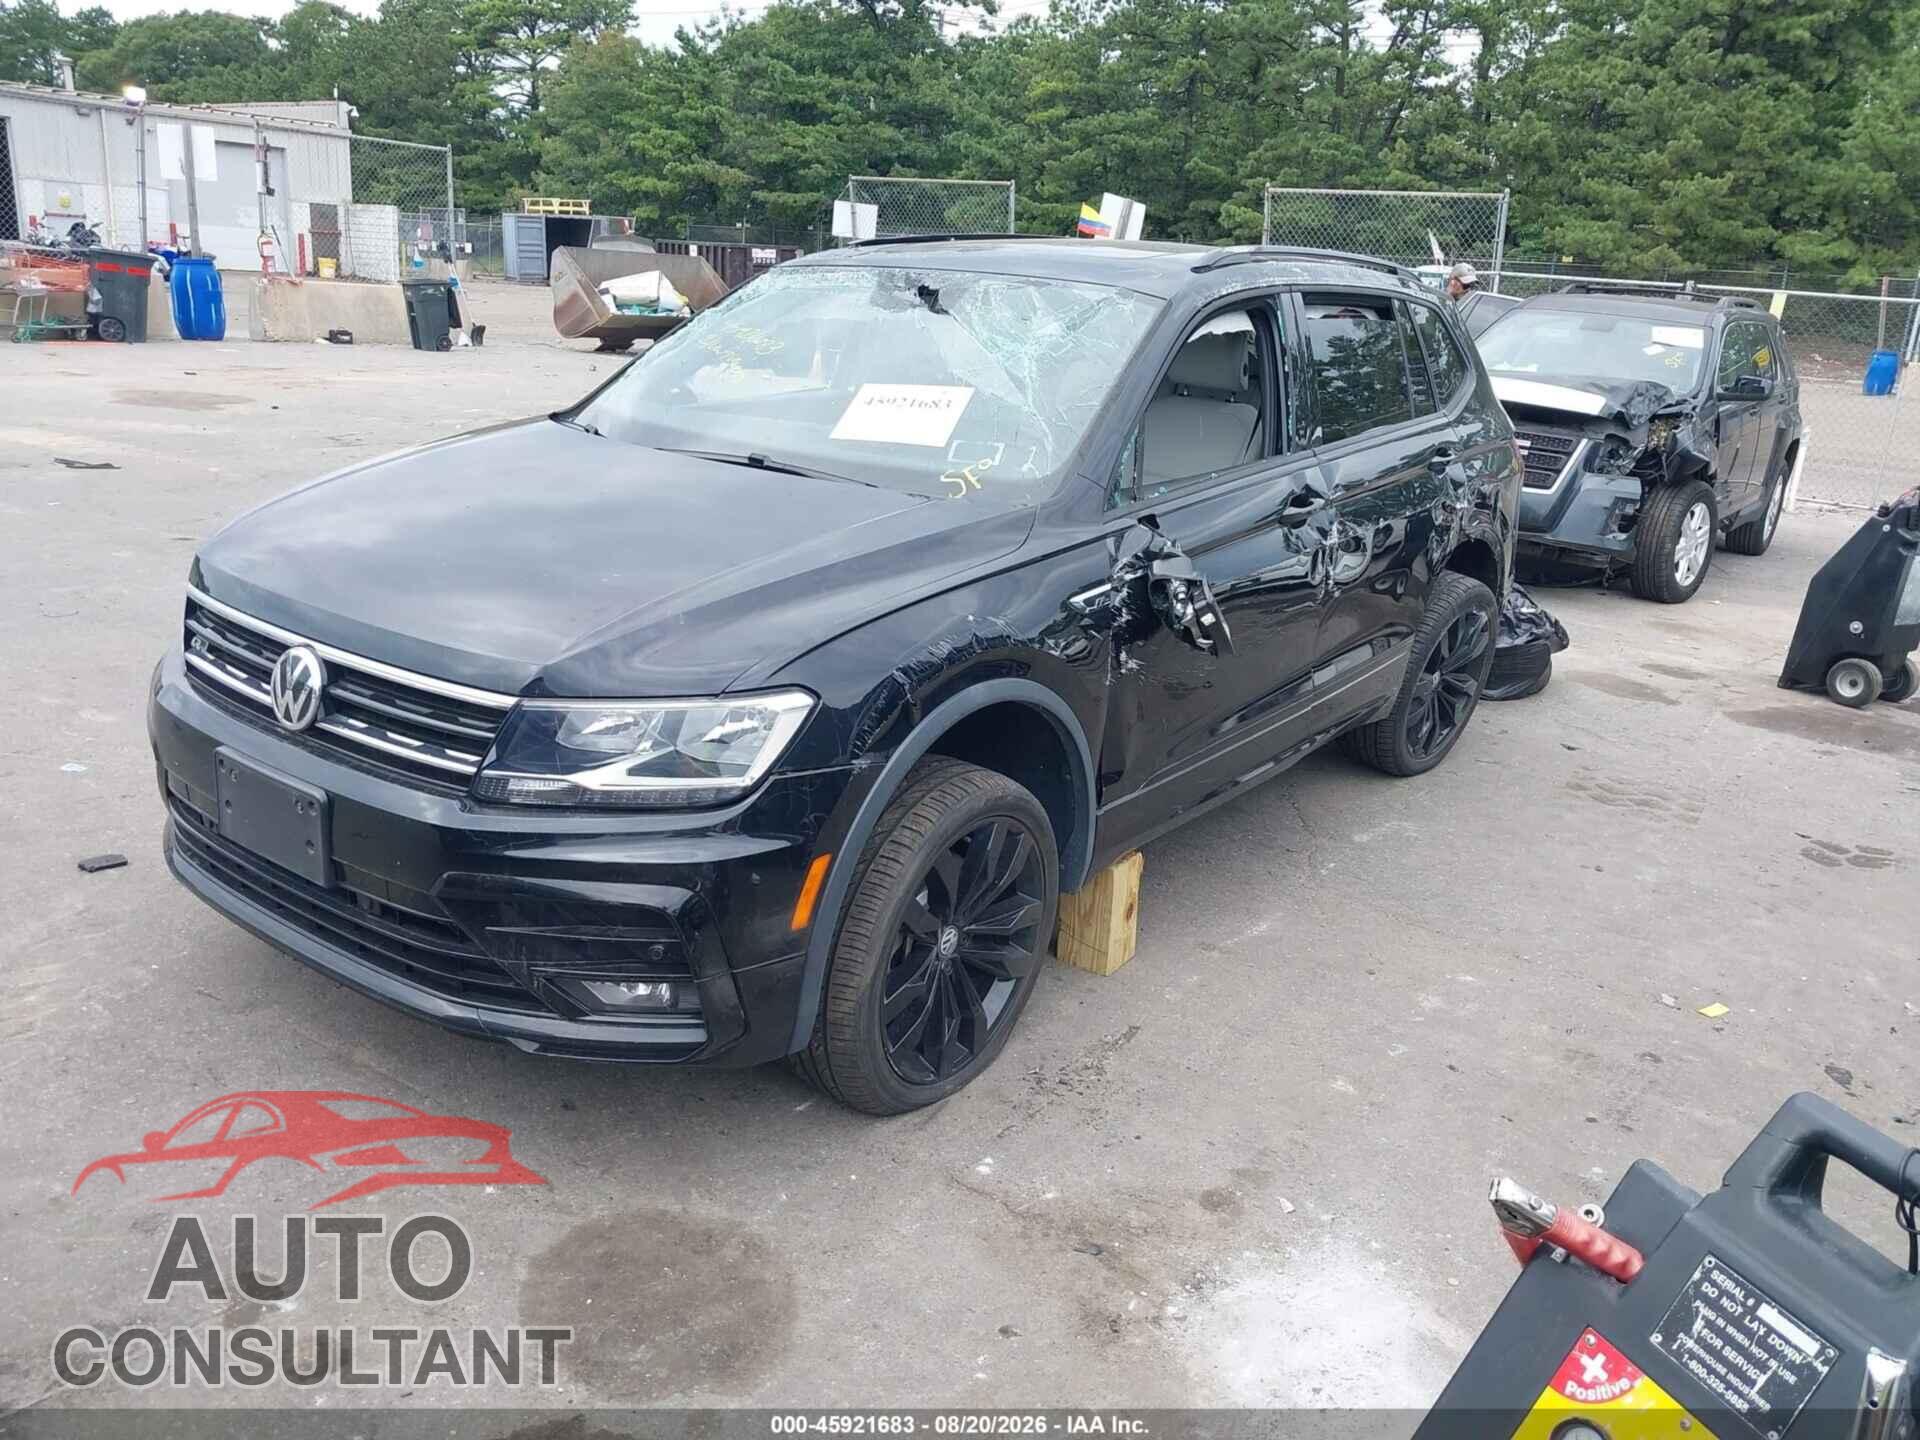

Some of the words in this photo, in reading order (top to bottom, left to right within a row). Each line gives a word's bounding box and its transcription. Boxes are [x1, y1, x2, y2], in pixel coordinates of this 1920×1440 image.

[1709, 1269, 1746, 1302] SERIAL
[1700, 1281, 1719, 1299] DO
[1720, 1295, 1744, 1317] NOT
[1744, 1314, 1768, 1336] LAY
[1767, 1333, 1804, 1364] DOWN
[1714, 1317, 1727, 1329] IN
[1725, 1324, 1751, 1348] WHEN
[1749, 1342, 1770, 1362] NOT
[1778, 1366, 1798, 1385] USE
[1700, 1328, 1724, 1350] FOR
[1722, 1345, 1768, 1386] SERVIC
[1564, 1377, 1632, 1401] Positive
